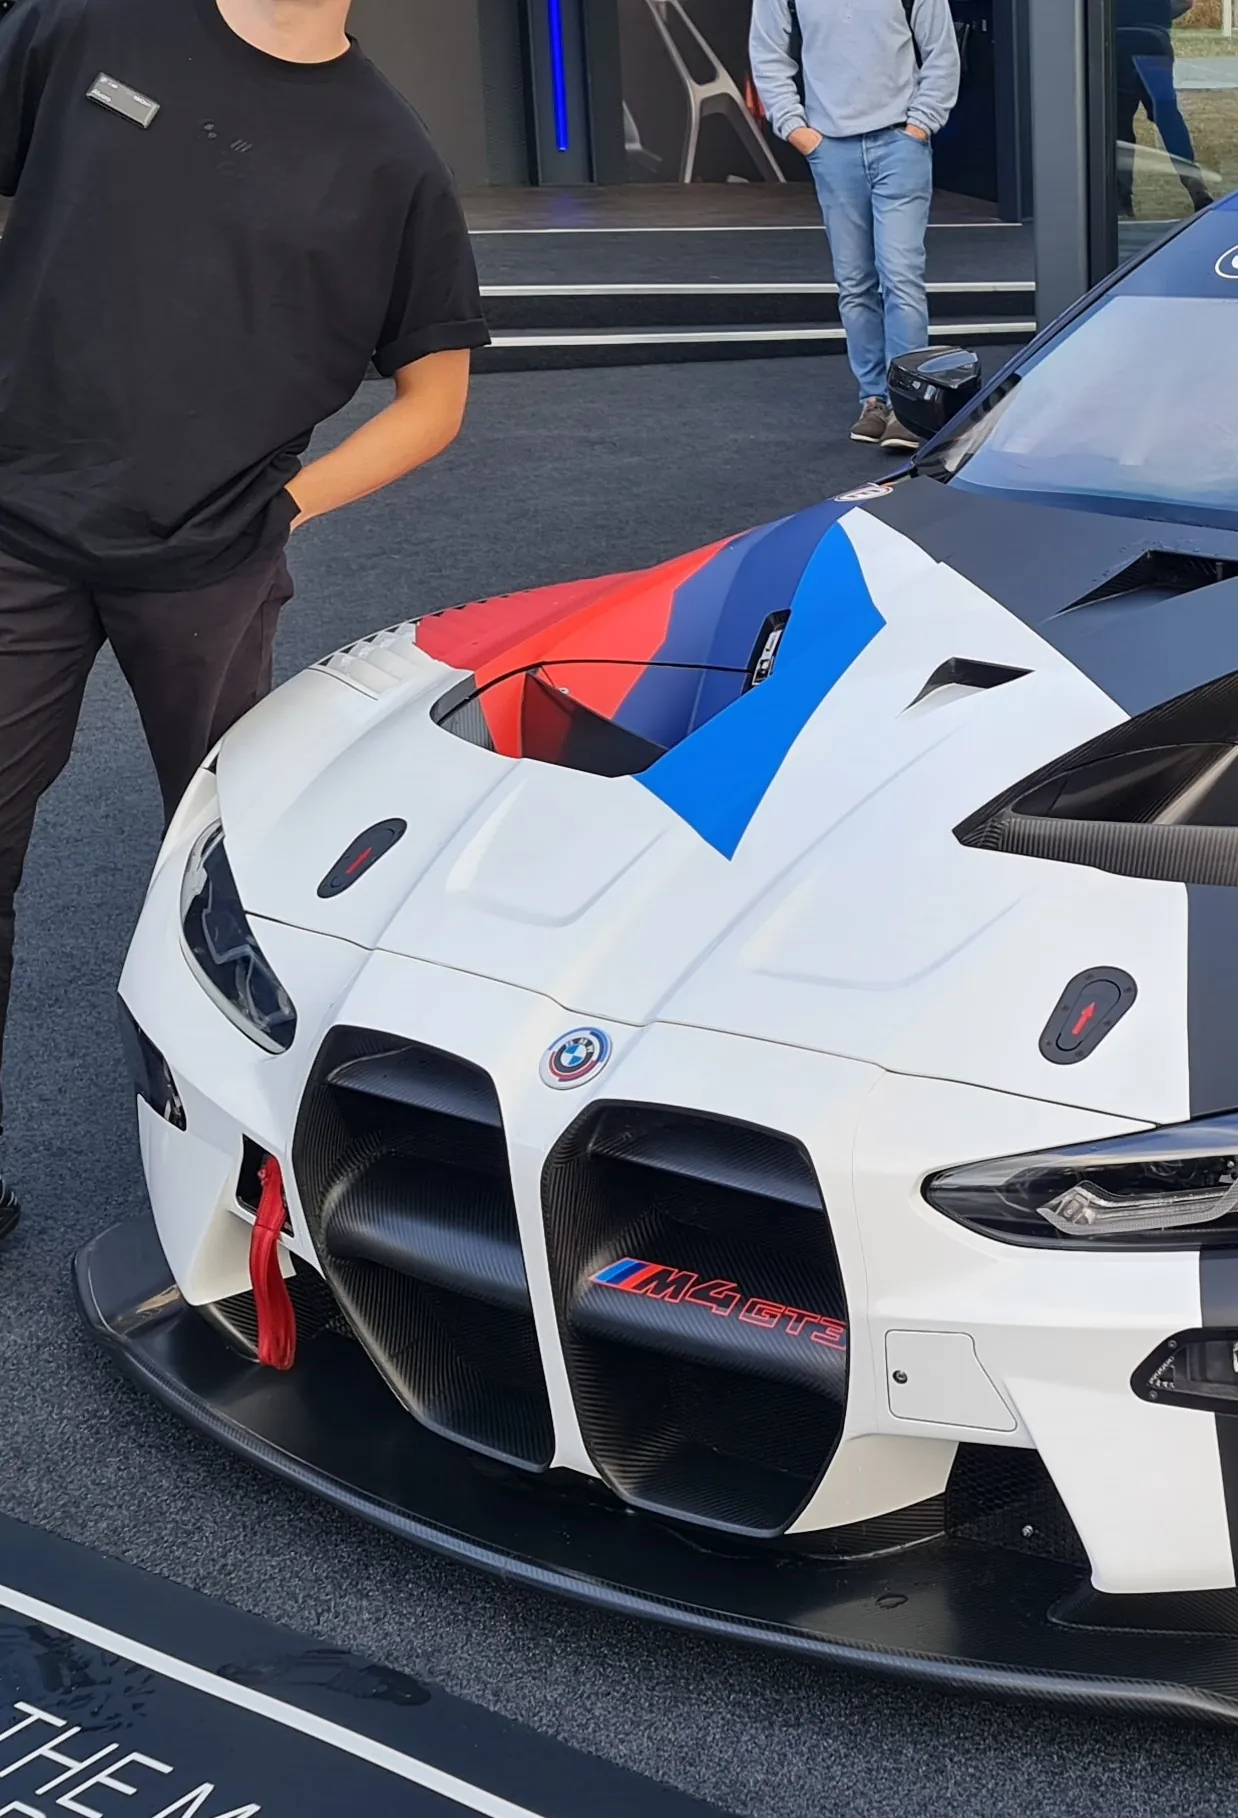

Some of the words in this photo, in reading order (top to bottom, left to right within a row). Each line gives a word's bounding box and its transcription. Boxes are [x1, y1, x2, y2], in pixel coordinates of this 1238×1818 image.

[634, 1265, 742, 1316] M4
[739, 1297, 847, 1350] GT3
[0, 1700, 174, 1818] THE
